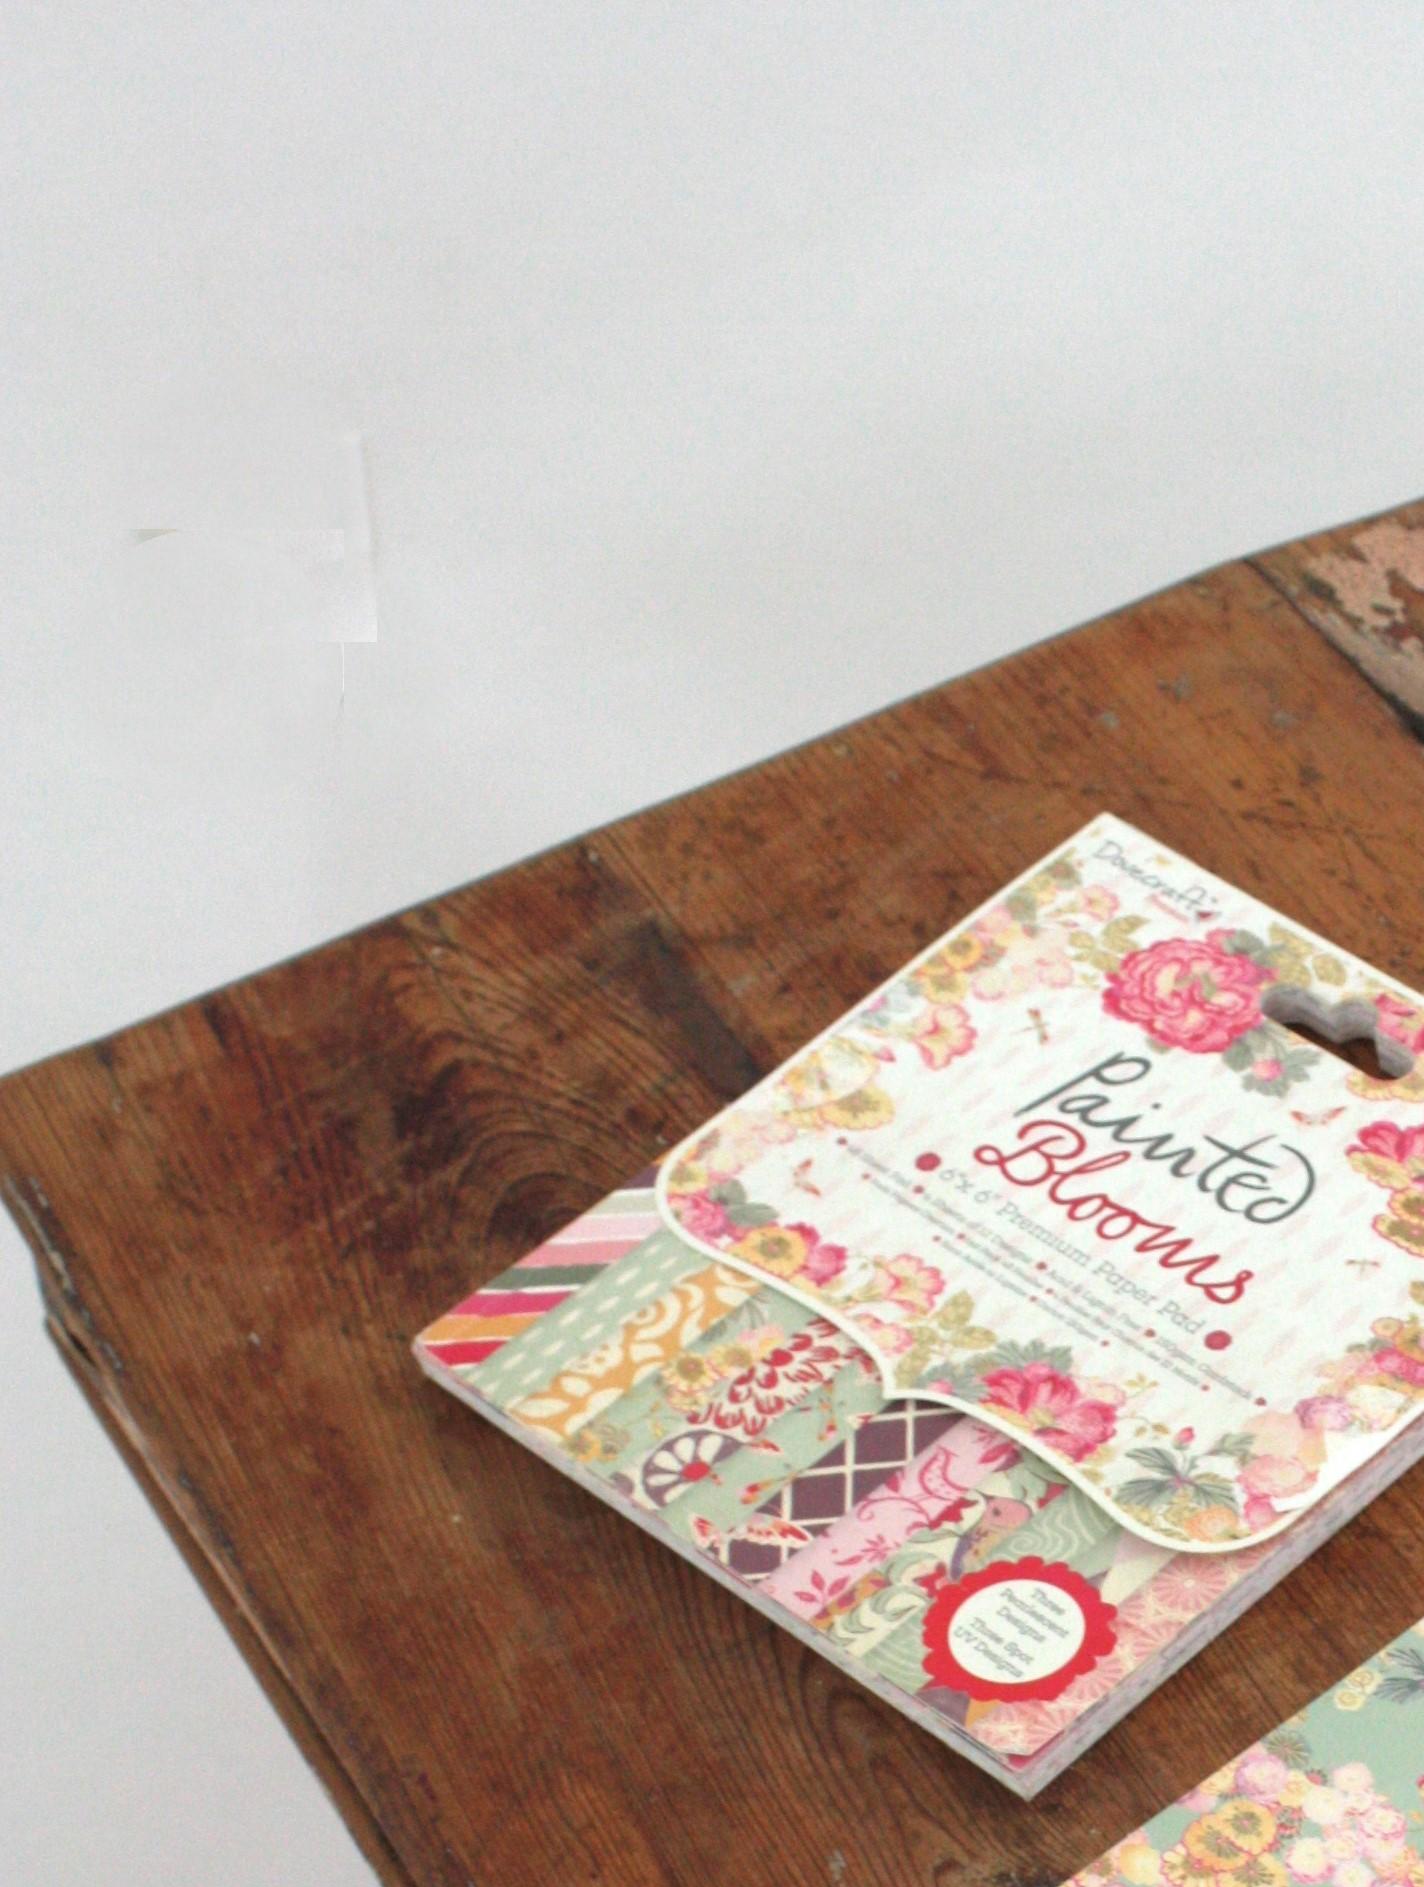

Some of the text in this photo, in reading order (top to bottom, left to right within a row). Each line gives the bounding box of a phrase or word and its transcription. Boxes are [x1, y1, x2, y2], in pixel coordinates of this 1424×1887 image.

[1091, 838, 1207, 910] Dovecraft
[1013, 1051, 1316, 1225] Painted
[973, 1119, 1254, 1305] Blooms
[994, 1200, 1093, 1268] Premium
[1089, 1259, 1159, 1307] Paper
[1155, 1299, 1207, 1335] Pad
[993, 1604, 1048, 1644] Designs
[1029, 1587, 1066, 1616] Three
[968, 1616, 1036, 1666] Three Spot
[972, 1639, 1024, 1679] Designs
